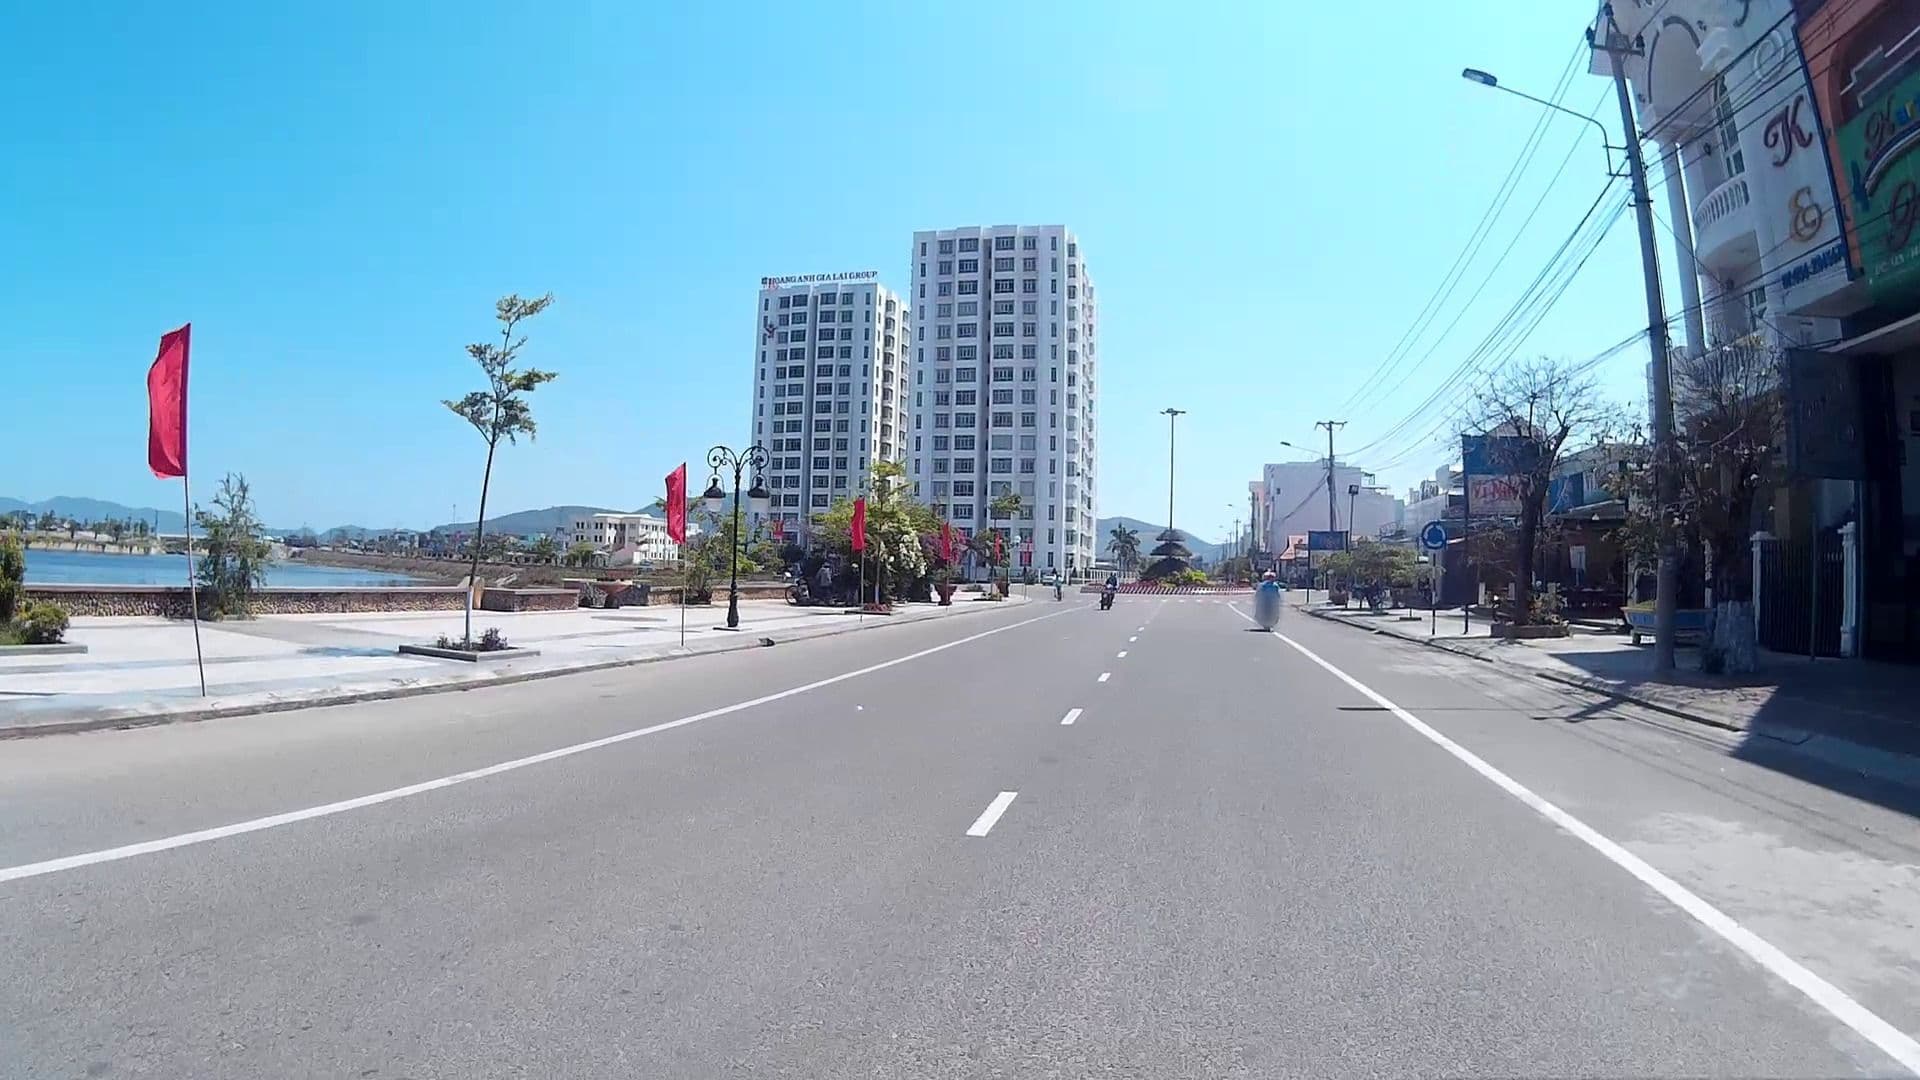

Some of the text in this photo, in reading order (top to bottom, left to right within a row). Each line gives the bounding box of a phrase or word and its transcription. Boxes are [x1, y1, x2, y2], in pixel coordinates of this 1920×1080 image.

[797, 274, 815, 283] ANH
[816, 273, 831, 282] GIA
[832, 272, 848, 281] LAI
[849, 271, 878, 280] GROUP
